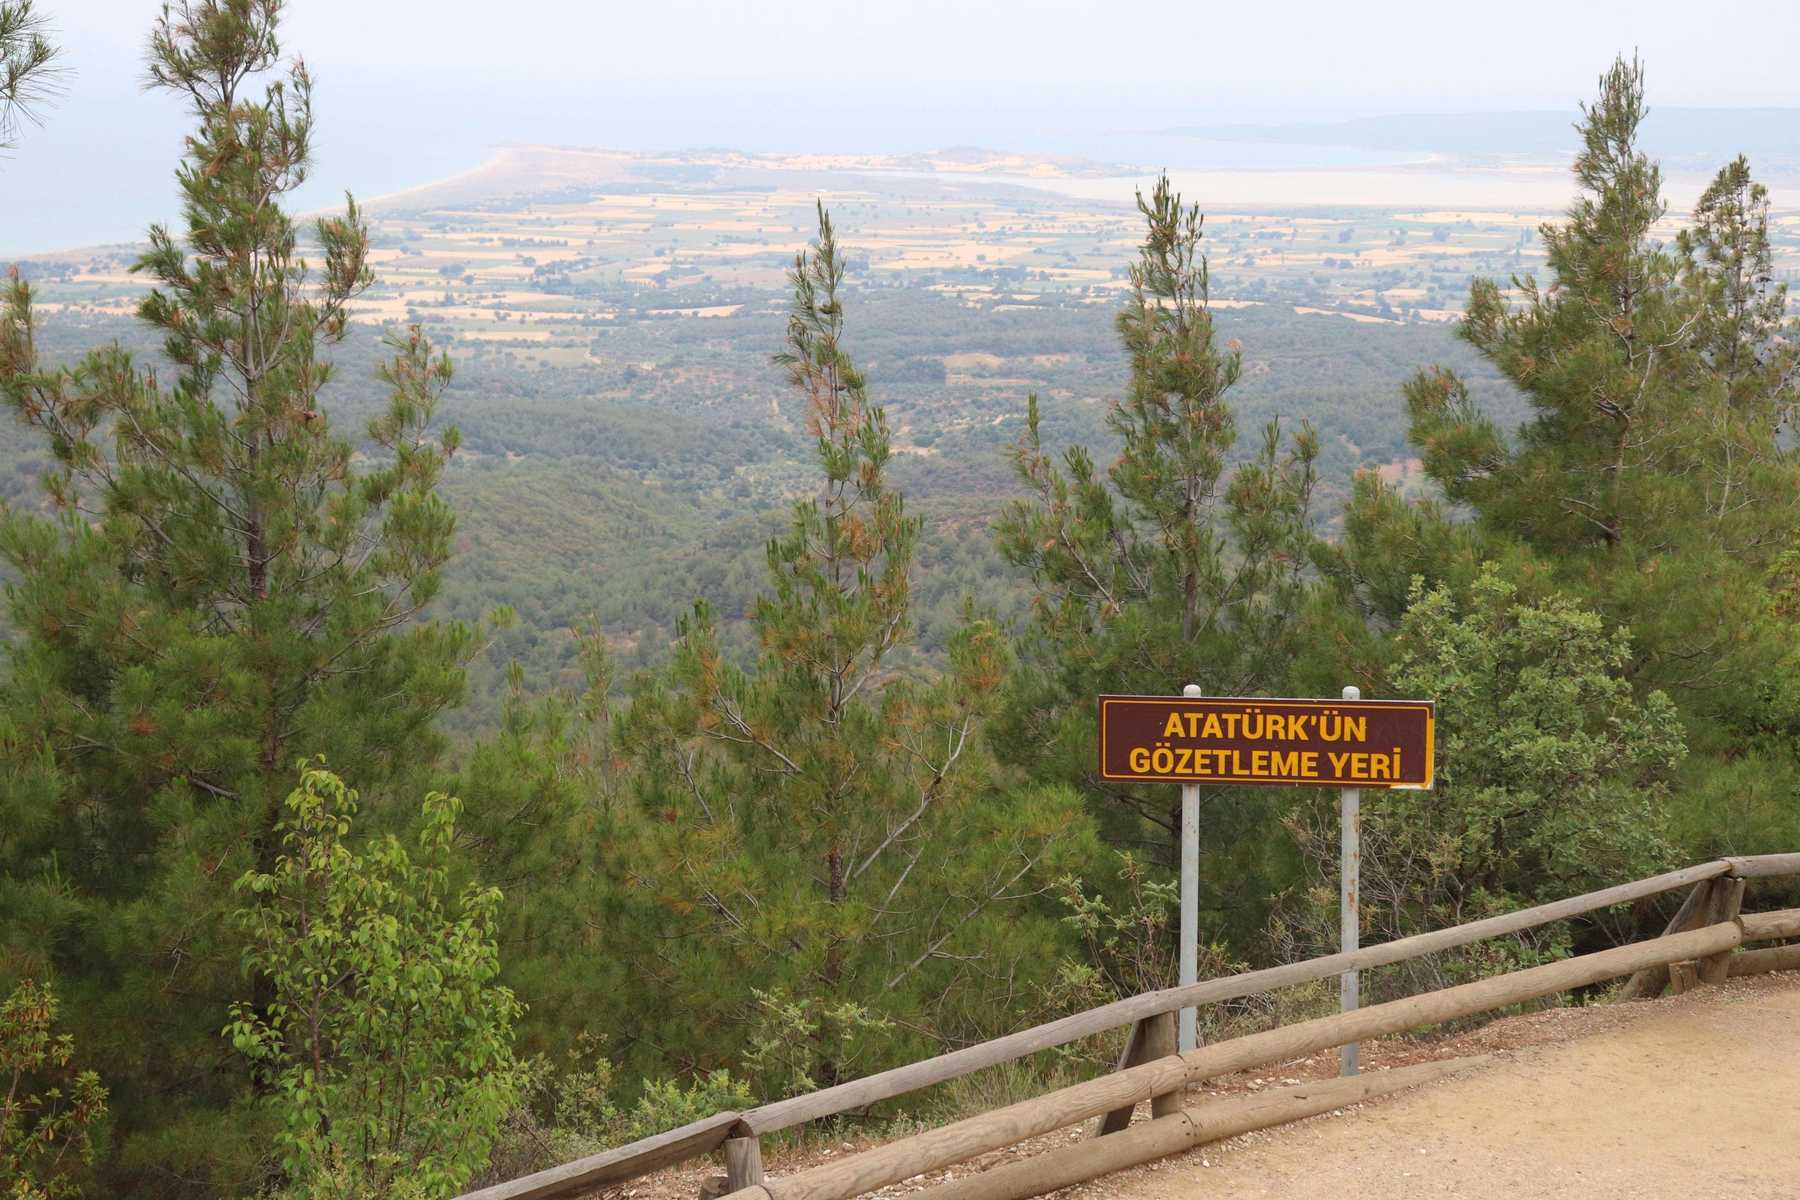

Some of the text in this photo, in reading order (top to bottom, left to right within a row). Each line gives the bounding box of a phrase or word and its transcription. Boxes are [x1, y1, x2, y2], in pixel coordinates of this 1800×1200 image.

[1163, 708, 1366, 742] ATATÜRK'ÜN
[1129, 742, 1401, 779] GÖZETLEME YERİ
